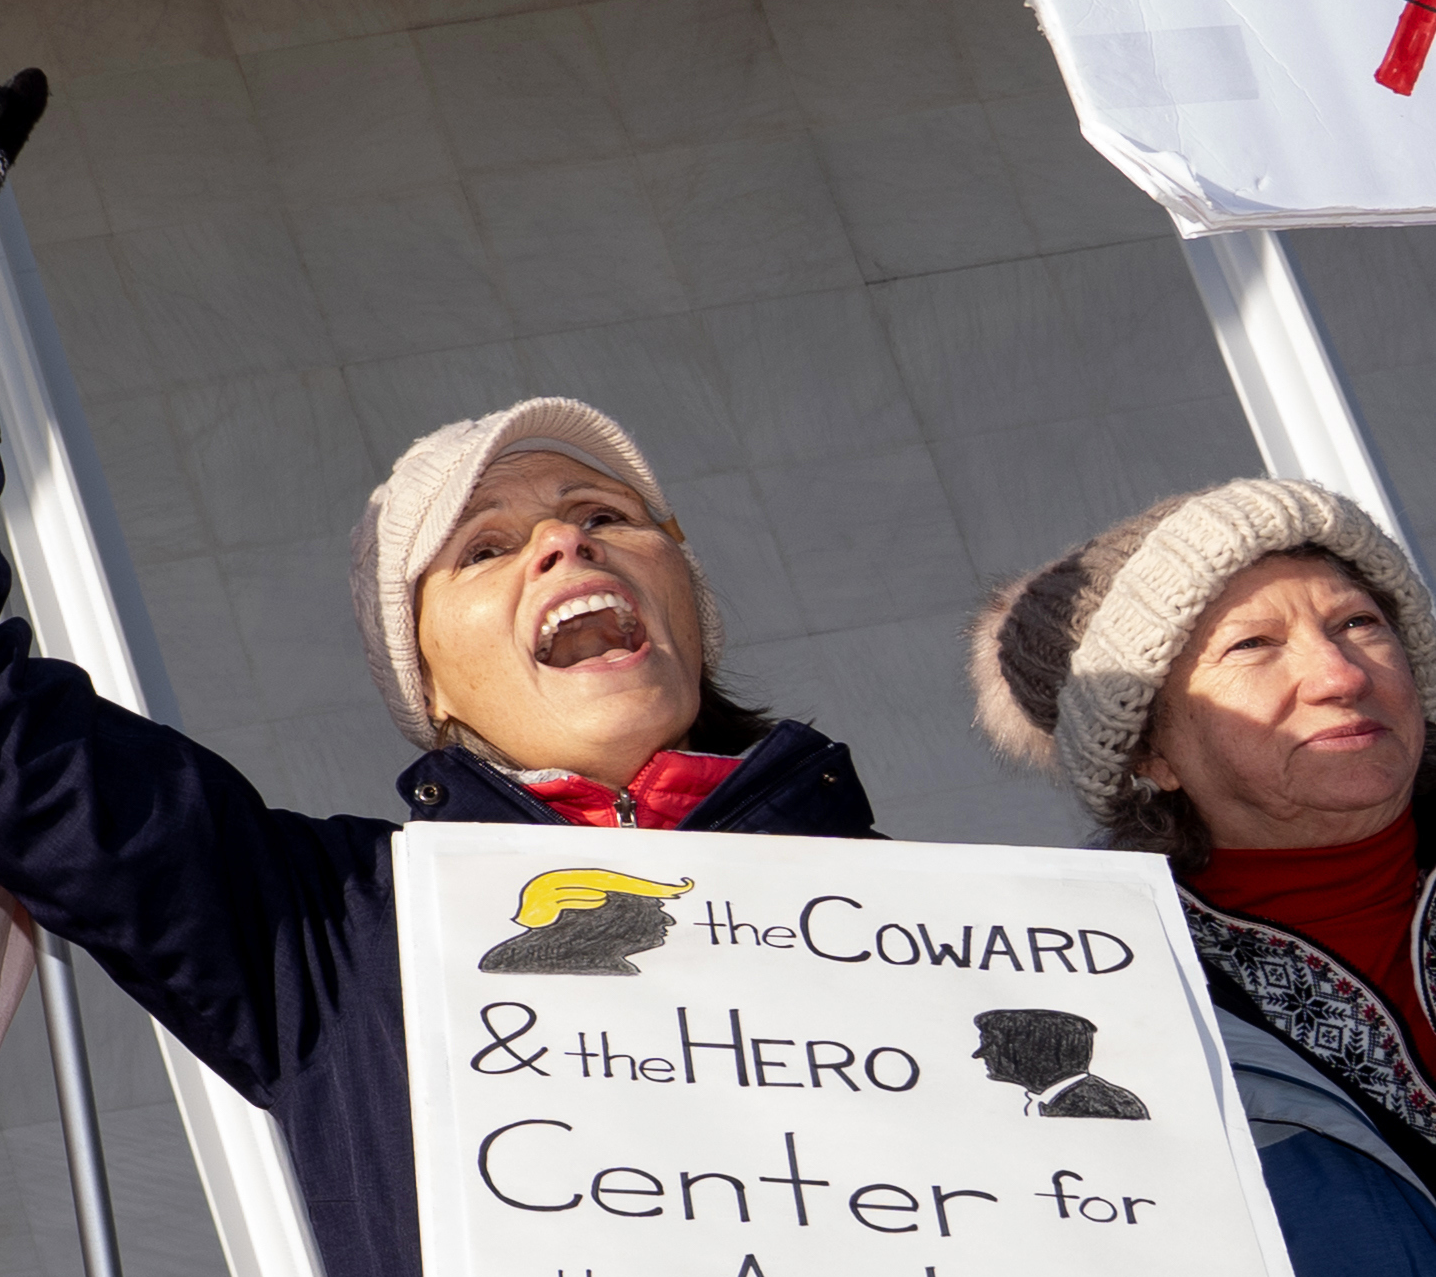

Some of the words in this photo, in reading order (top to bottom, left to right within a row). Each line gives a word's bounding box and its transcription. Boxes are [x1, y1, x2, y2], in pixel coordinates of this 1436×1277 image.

[693, 899, 797, 953] the
[468, 1000, 551, 1079] &
[563, 1030, 675, 1086] the
[676, 1005, 922, 1095] HERO
[477, 1117, 1000, 1240] Center
[1034, 1168, 1157, 1226] for
